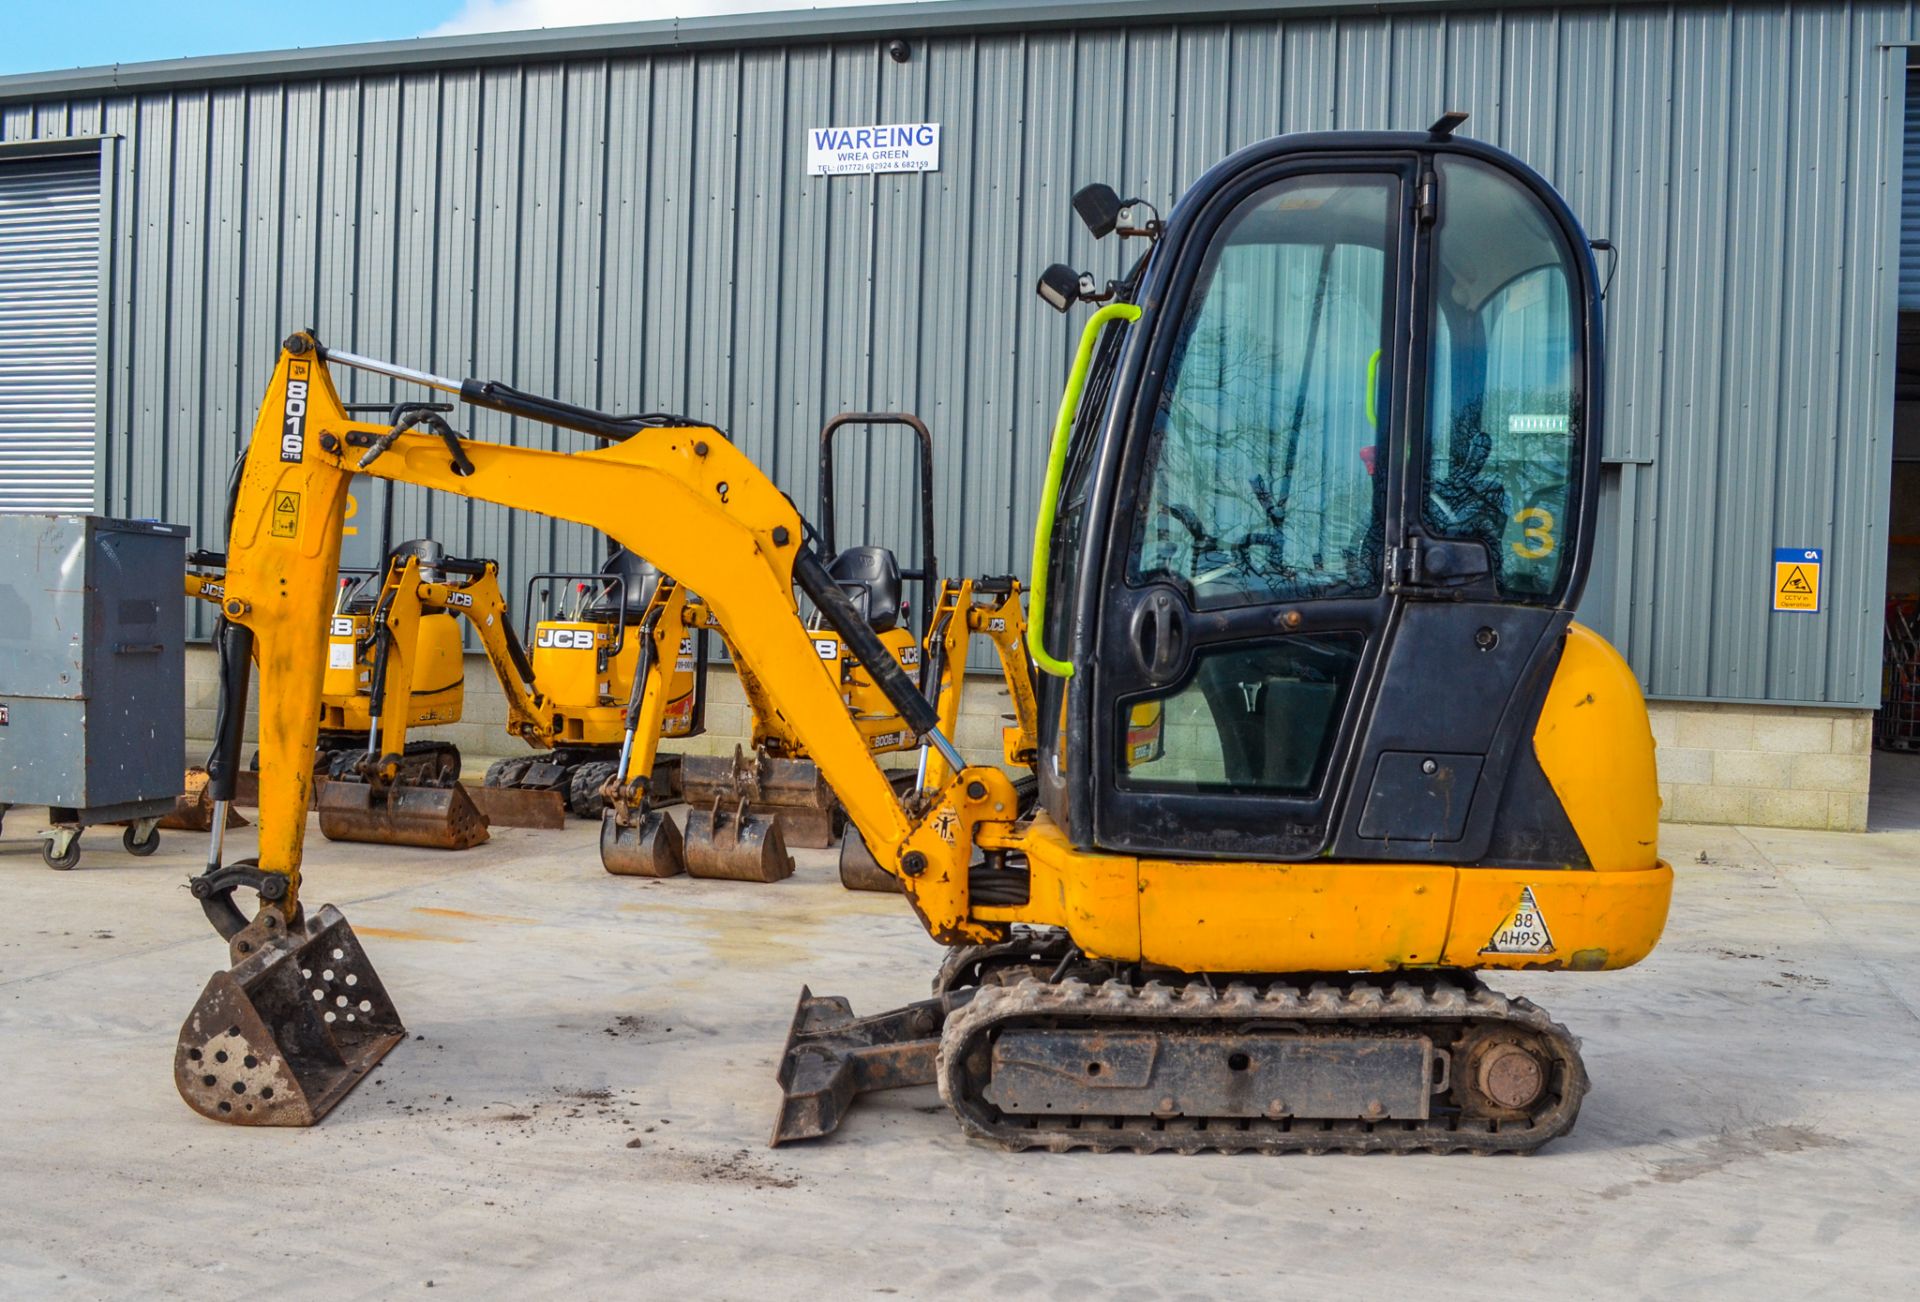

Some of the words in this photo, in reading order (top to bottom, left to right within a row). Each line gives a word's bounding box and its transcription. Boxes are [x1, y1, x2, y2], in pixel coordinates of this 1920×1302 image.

[815, 126, 934, 151] WAREING
[837, 152, 869, 162] WREA
[872, 150, 909, 160] GREEN
[281, 380, 308, 454] 8016
[1511, 507, 1557, 560] 3
[447, 592, 472, 606] JCB
[986, 618, 1005, 631] JCB
[538, 630, 593, 649] JCB
[1514, 913, 1533, 928] 88
[1499, 931, 1541, 946] AH9S
